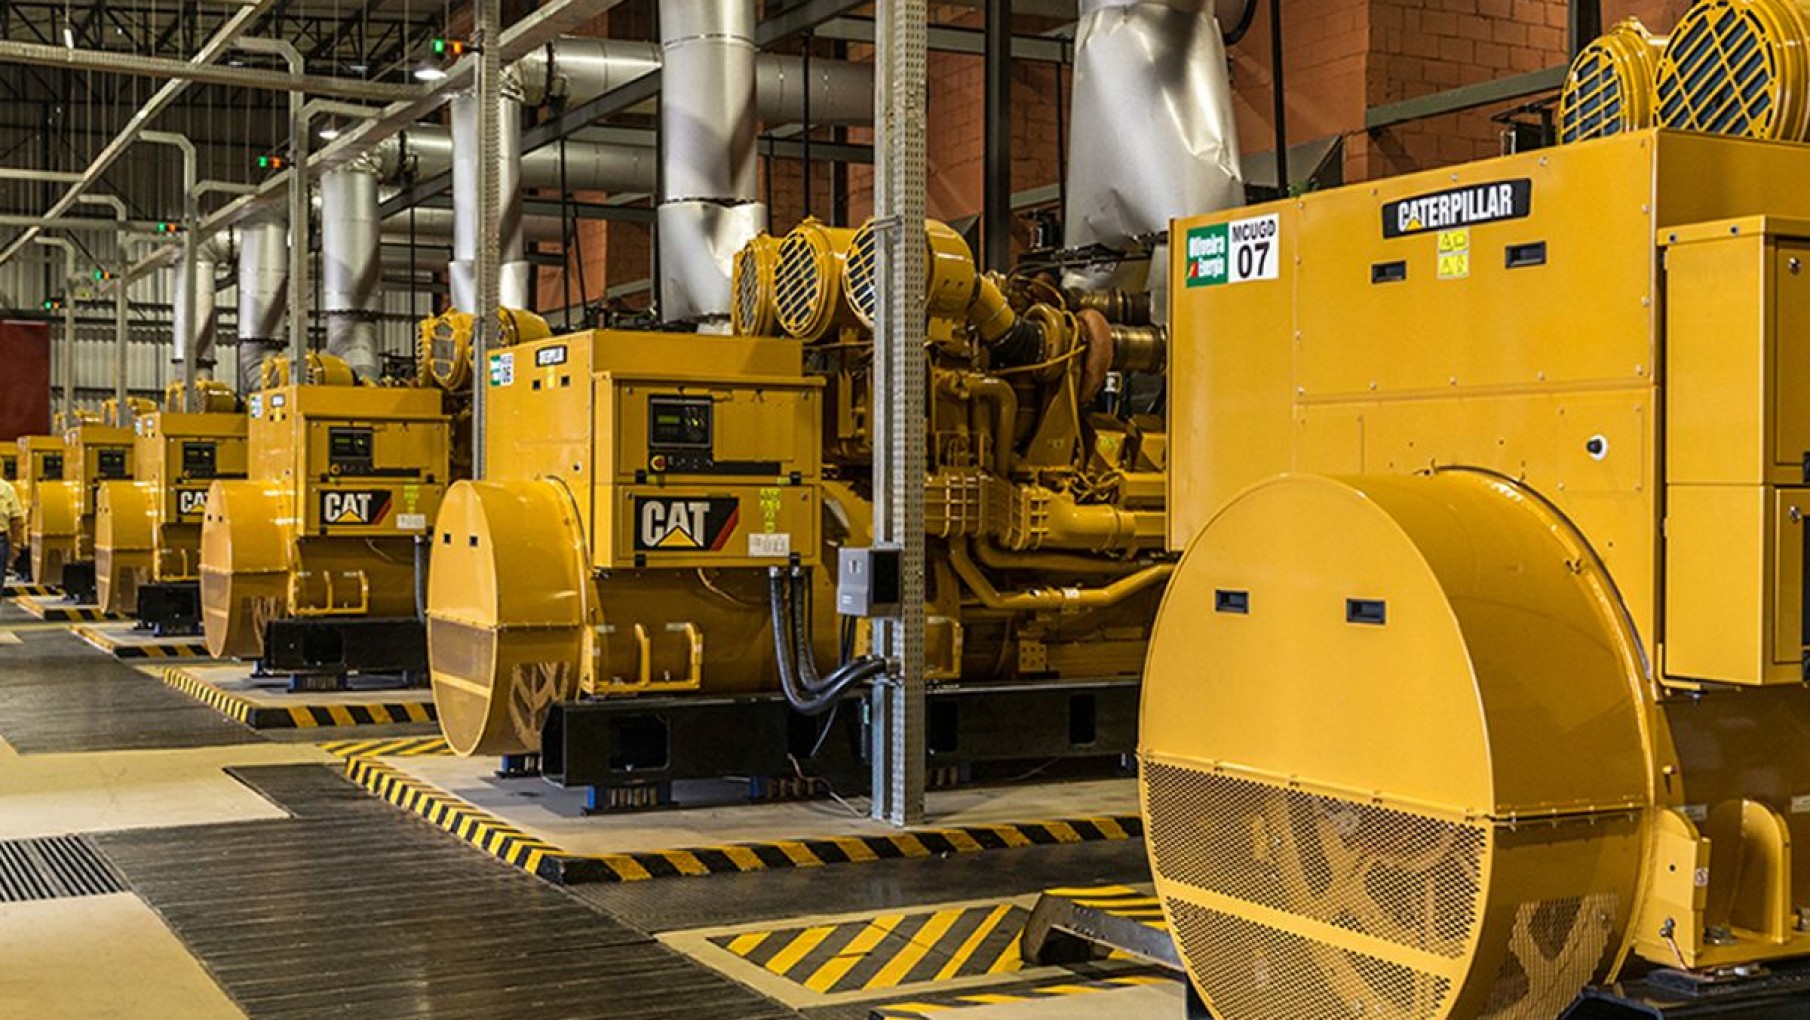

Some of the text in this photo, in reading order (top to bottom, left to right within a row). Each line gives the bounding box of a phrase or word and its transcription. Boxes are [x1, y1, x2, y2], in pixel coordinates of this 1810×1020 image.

[1398, 184, 1512, 231] CATERPILLAR
[1232, 219, 1276, 243] MCUGD
[1237, 241, 1270, 278] 07
[180, 491, 208, 513] CA
[325, 493, 372, 522] CAT
[641, 501, 710, 547] CAT
